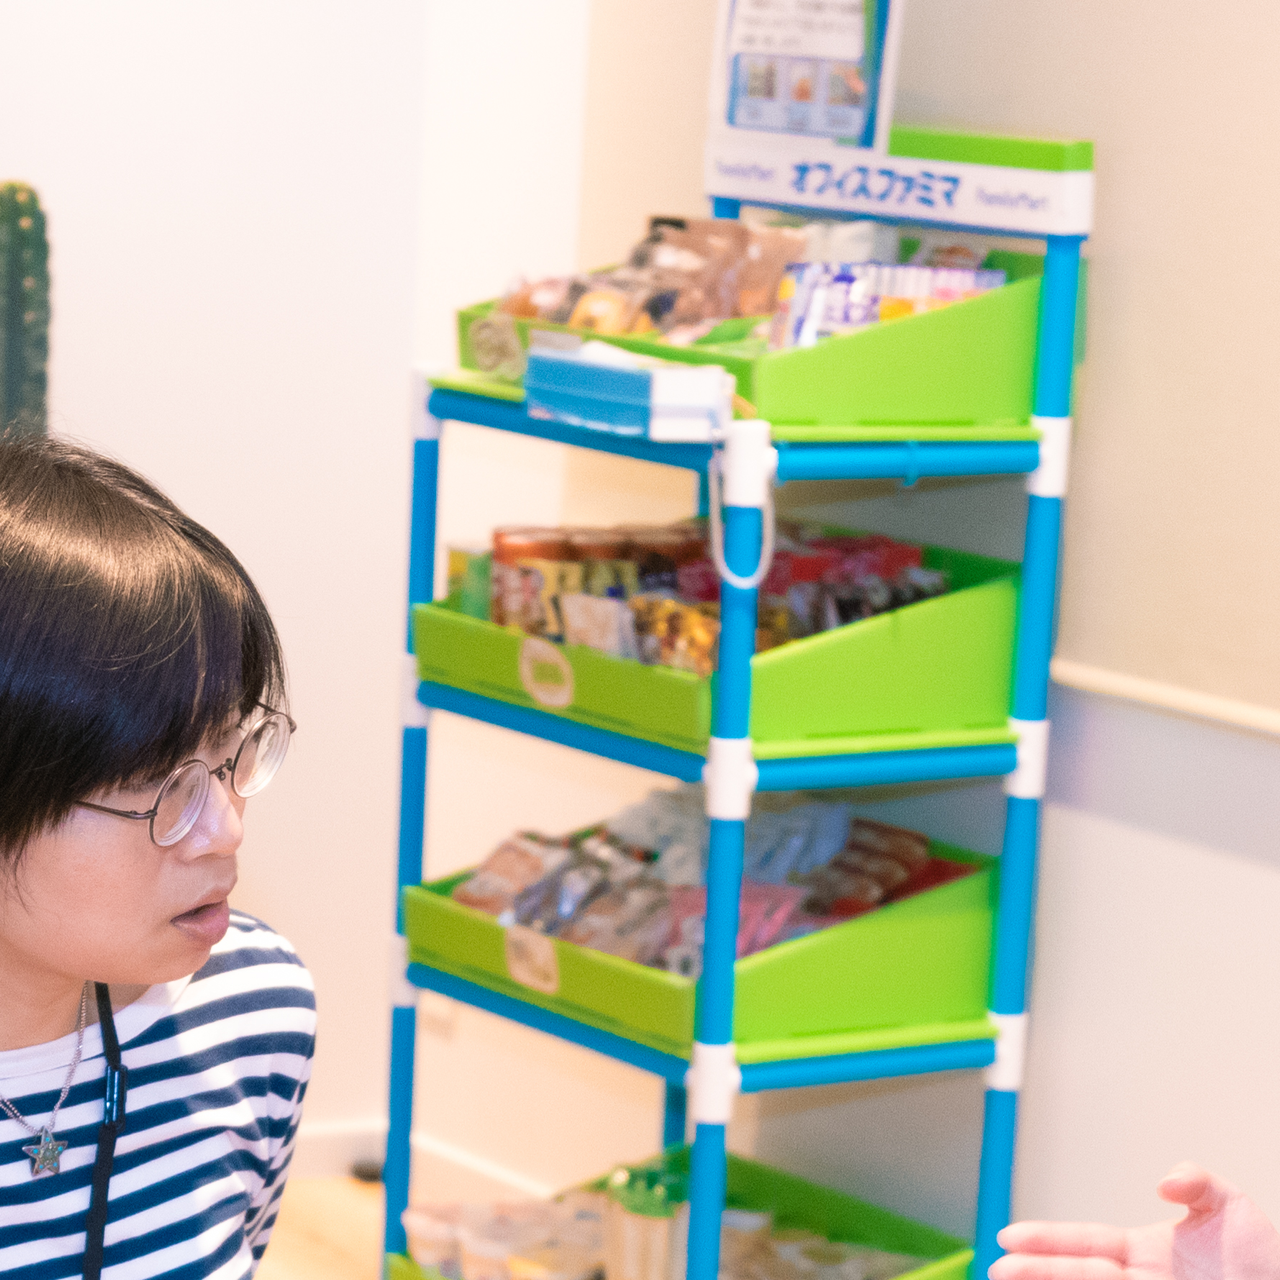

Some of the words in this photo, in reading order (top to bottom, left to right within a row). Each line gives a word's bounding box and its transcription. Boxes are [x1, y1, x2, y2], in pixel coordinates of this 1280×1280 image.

[791, 162, 961, 208] オフィスファミマ
